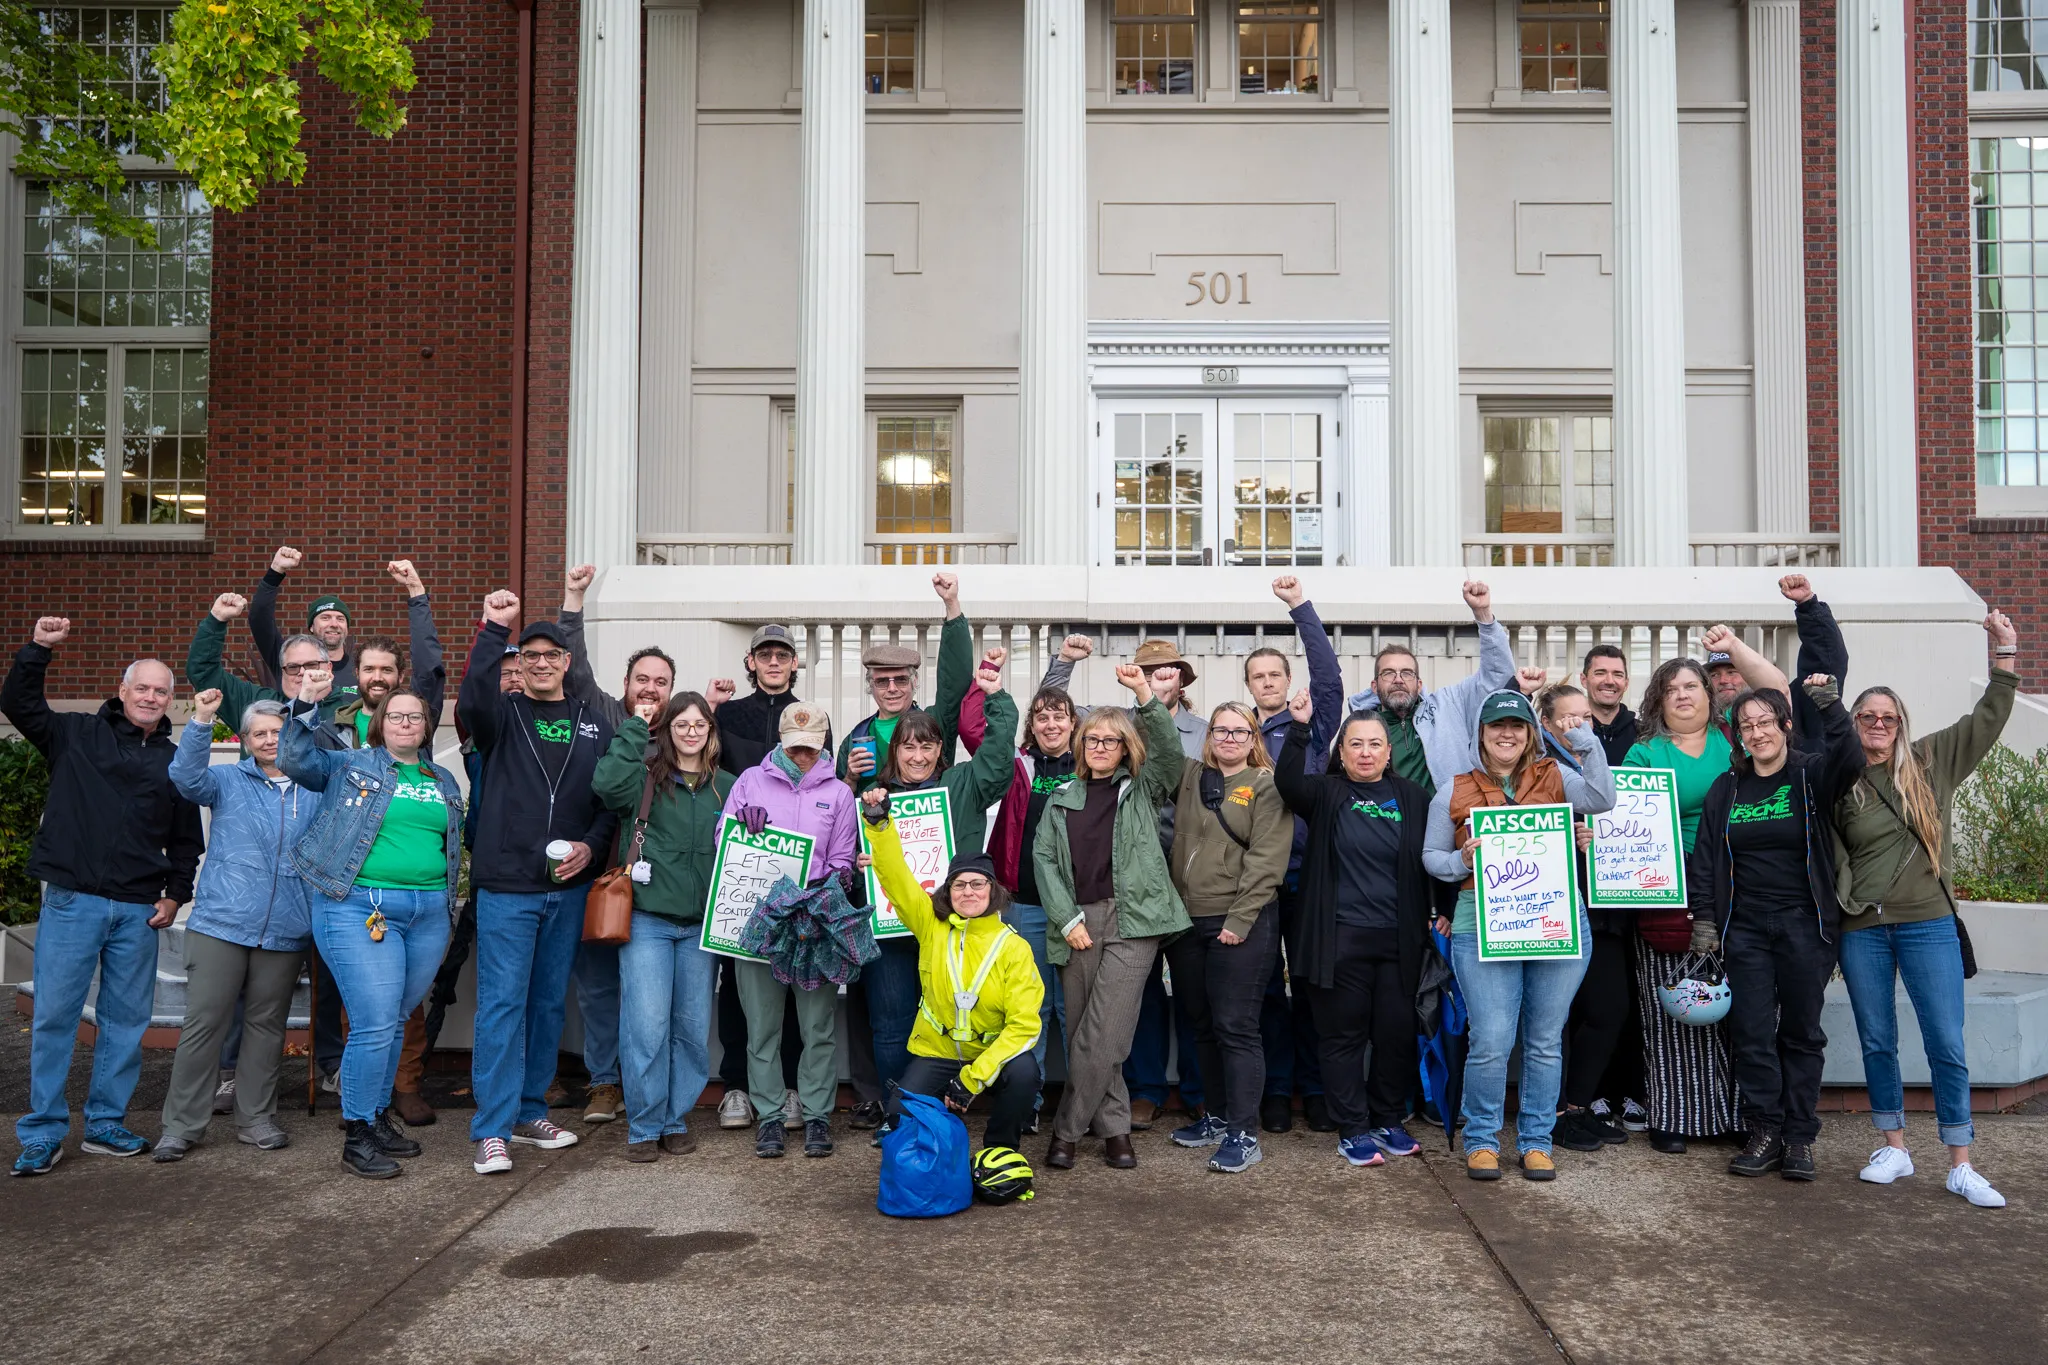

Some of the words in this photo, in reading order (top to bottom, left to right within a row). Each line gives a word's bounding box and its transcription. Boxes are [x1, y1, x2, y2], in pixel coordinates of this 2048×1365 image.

[1185, 271, 1252, 307] 501
[1206, 368, 1235, 382] 501
[1614, 773, 1669, 791] SCME
[890, 795, 943, 818] SCME
[1610, 793, 1661, 817] -25
[1479, 811, 1565, 833] AFSCME
[727, 824, 807, 857] AFSCME
[913, 826, 940, 840] VOTE
[1597, 818, 1655, 846] Dolly
[1491, 834, 1548, 857] 9-25
[723, 842, 781, 875] LET'S
[1483, 858, 1540, 891] Dolly
[1634, 867, 1670, 885] Today
[718, 885, 726, 900] A
[729, 888, 768, 904] GRE
[1596, 890, 1631, 898] OREGON
[1631, 890, 1667, 898] COUNCIL
[1668, 890, 1679, 898] 75
[714, 902, 752, 917] CONTR
[1516, 901, 1555, 915] GREAT
[877, 919, 904, 928] OREGO
[1489, 917, 1540, 933] CONTRACT
[708, 936, 741, 950] OREGON
[1486, 941, 1523, 950] OREGON
[1523, 940, 1561, 949] COUNCIL
[1562, 940, 1573, 948] 75
